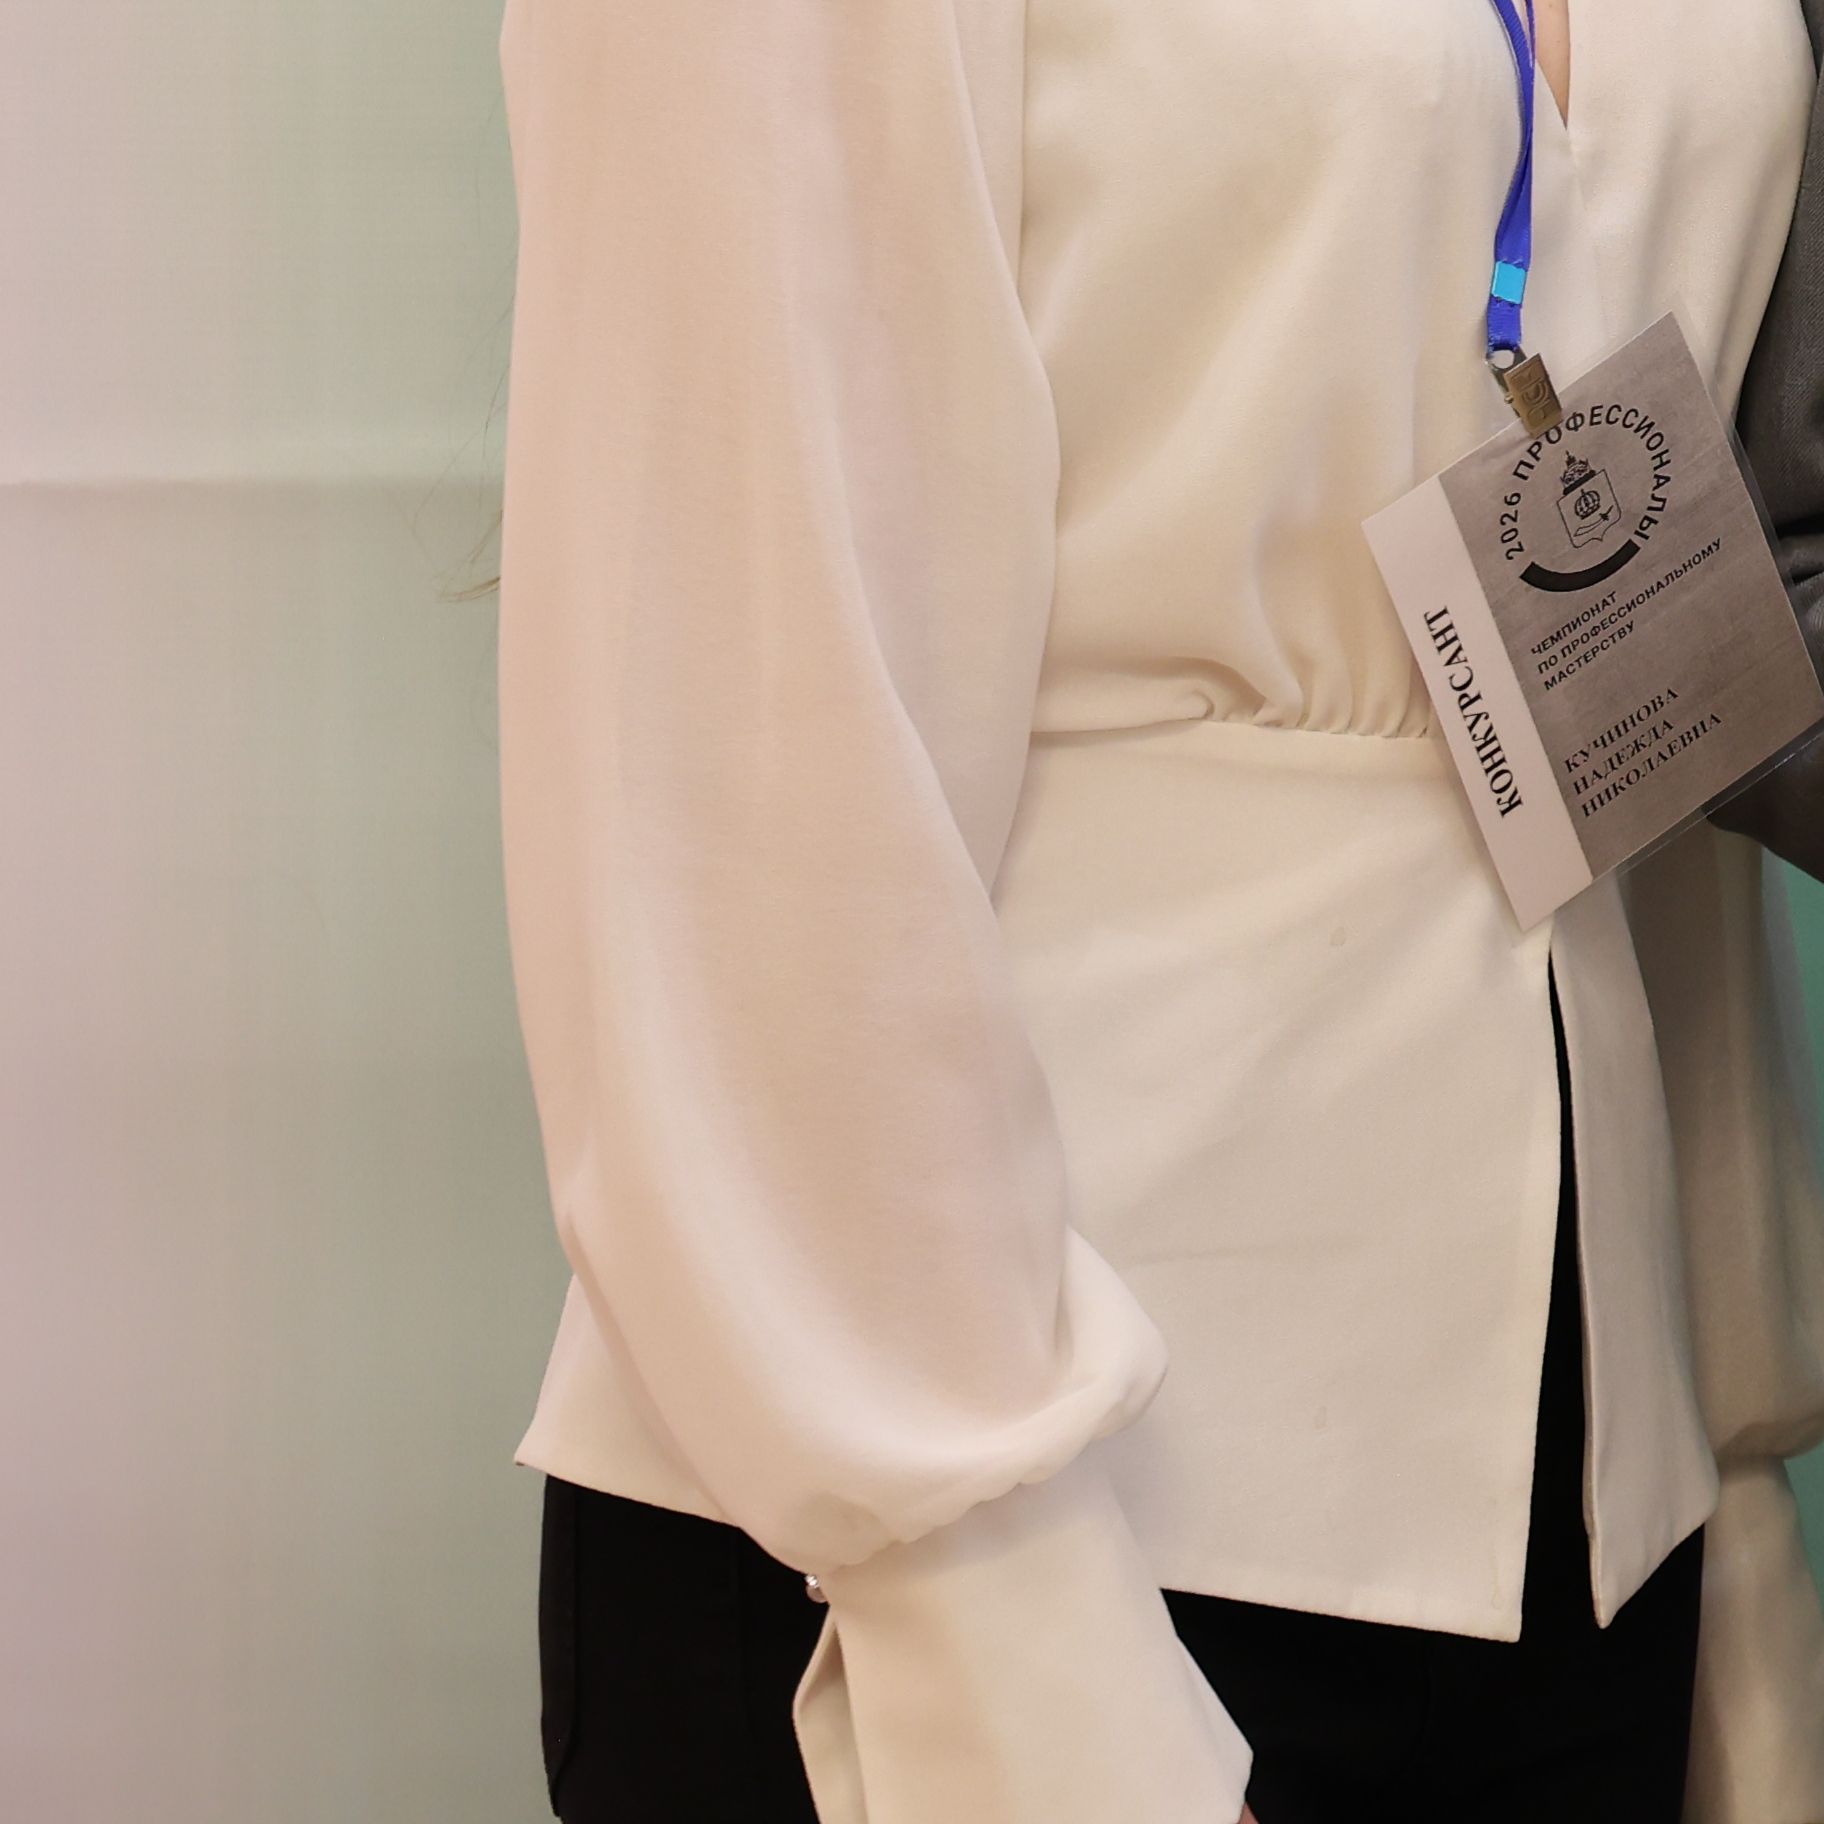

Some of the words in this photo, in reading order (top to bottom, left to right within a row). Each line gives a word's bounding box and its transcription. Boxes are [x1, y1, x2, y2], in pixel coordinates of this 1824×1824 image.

[1499, 491, 1525, 561] 2026
[1512, 403, 1672, 541] ПРОФЕССИОНАЛЫ
[1530, 590, 1619, 657] ЧЕМПИОНАТ
[1537, 655, 1559, 675] ПО
[1560, 537, 1722, 659] ПРОФЕССИОНАЛЬНОМУ
[1543, 620, 1637, 691] МАСТЕРСТВУ
[1423, 605, 1524, 819] КОНКУРСАНТ
[1564, 688, 1680, 774] КУЧИНОВА
[1572, 719, 1675, 796] НАДЕЖДА
[1581, 712, 1722, 819] НИКОЛАЕВНА
